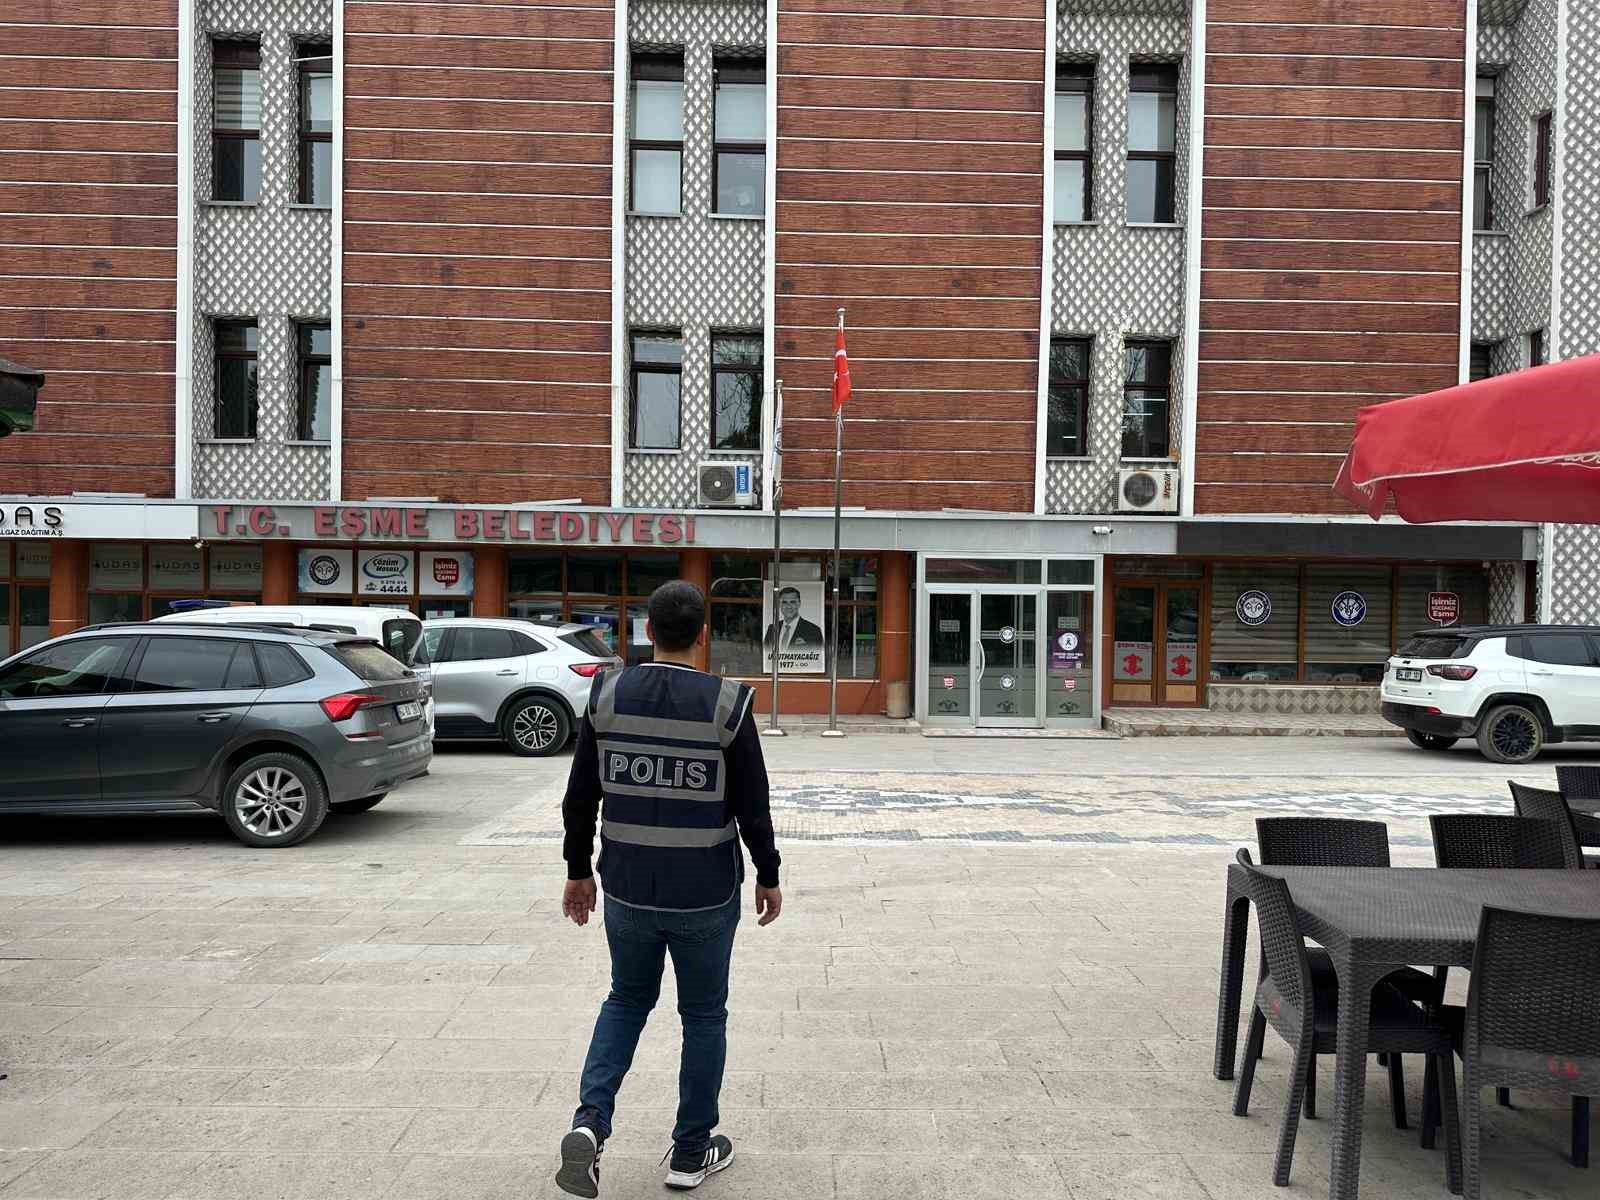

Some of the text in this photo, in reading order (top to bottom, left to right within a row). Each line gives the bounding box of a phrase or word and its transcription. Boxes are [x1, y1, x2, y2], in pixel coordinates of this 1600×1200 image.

[0, 506, 63, 528] AŞ
[210, 505, 290, 536] T.C.
[380, 585, 408, 593] 4444
[768, 652, 819, 660] UUTMAYACAĞIZ
